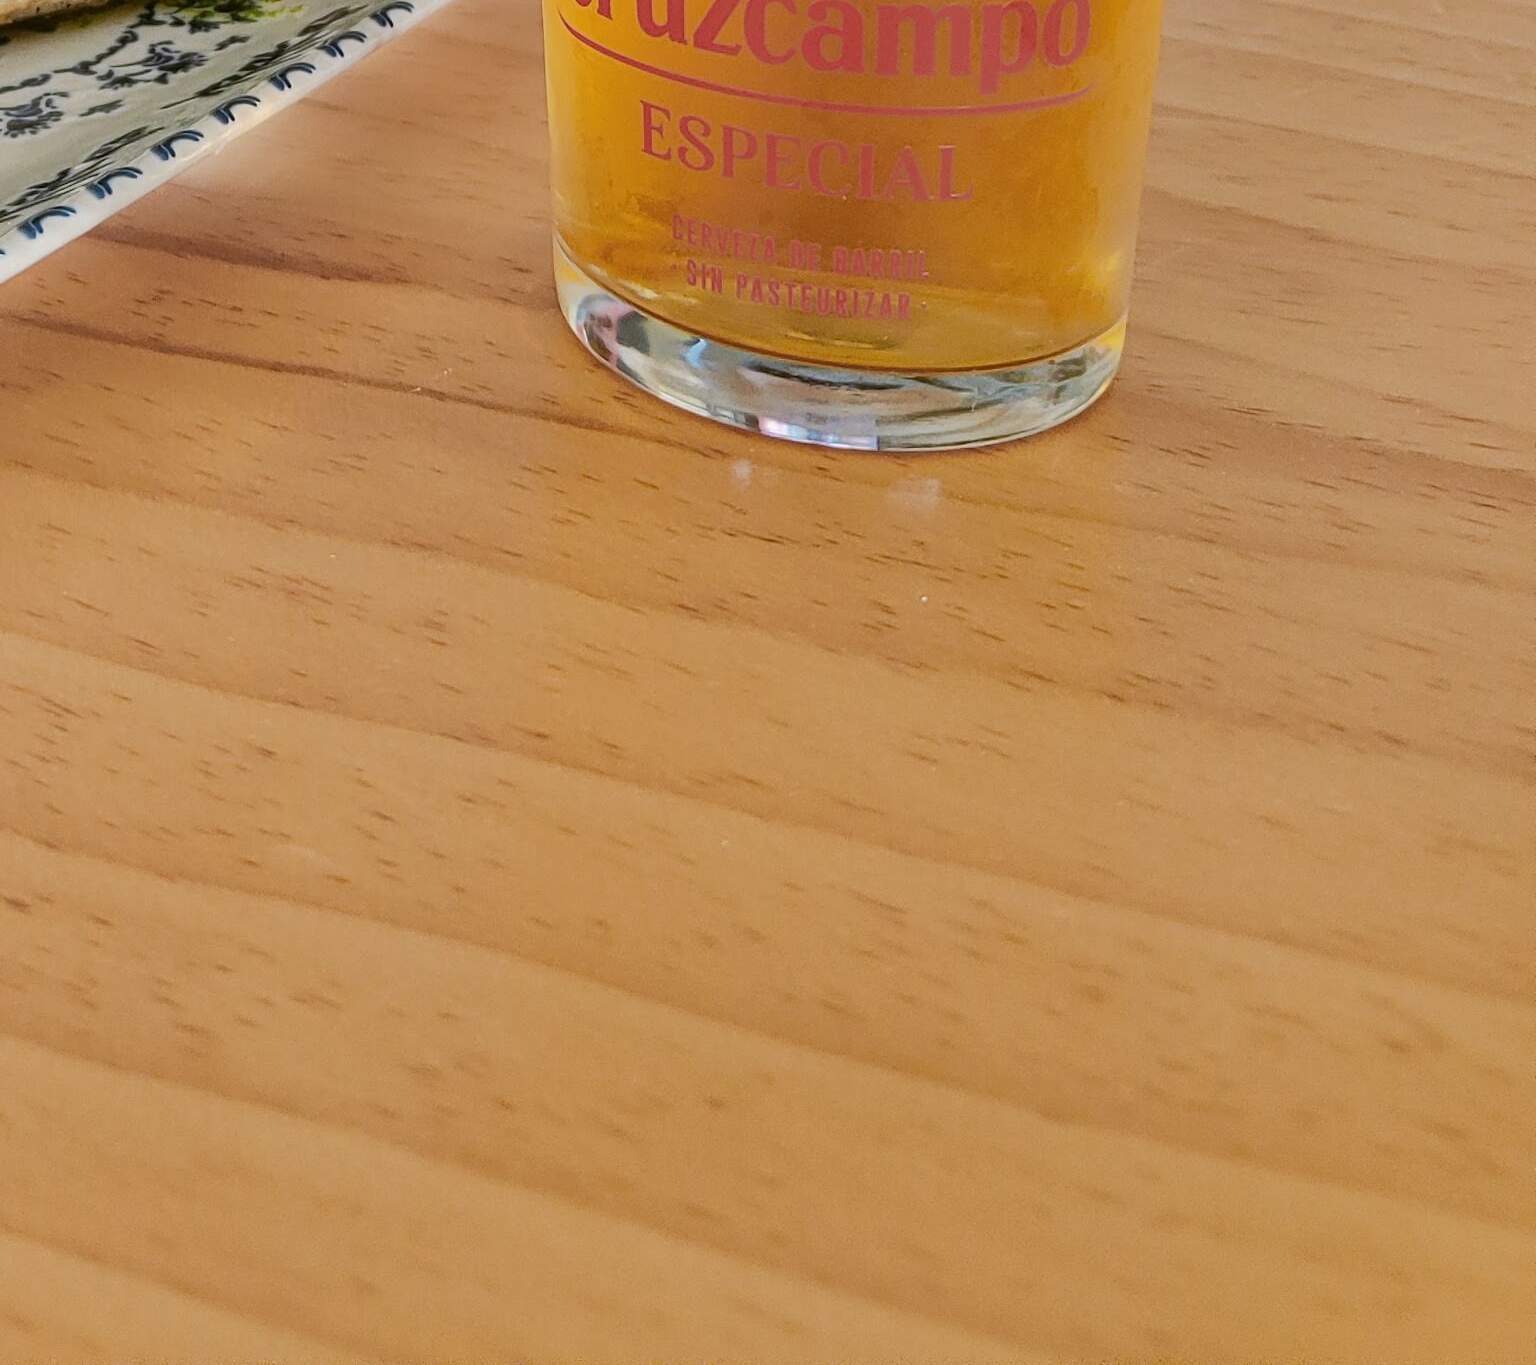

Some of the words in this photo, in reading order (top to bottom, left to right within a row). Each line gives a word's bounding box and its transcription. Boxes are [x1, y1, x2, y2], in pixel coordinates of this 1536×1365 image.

[639, 99, 974, 202] ESPECIAL
[672, 213, 776, 263] CERVEZA
[789, 237, 821, 272] DE
[686, 258, 724, 294] SIN
[735, 272, 914, 320] PASTEURIZAR
